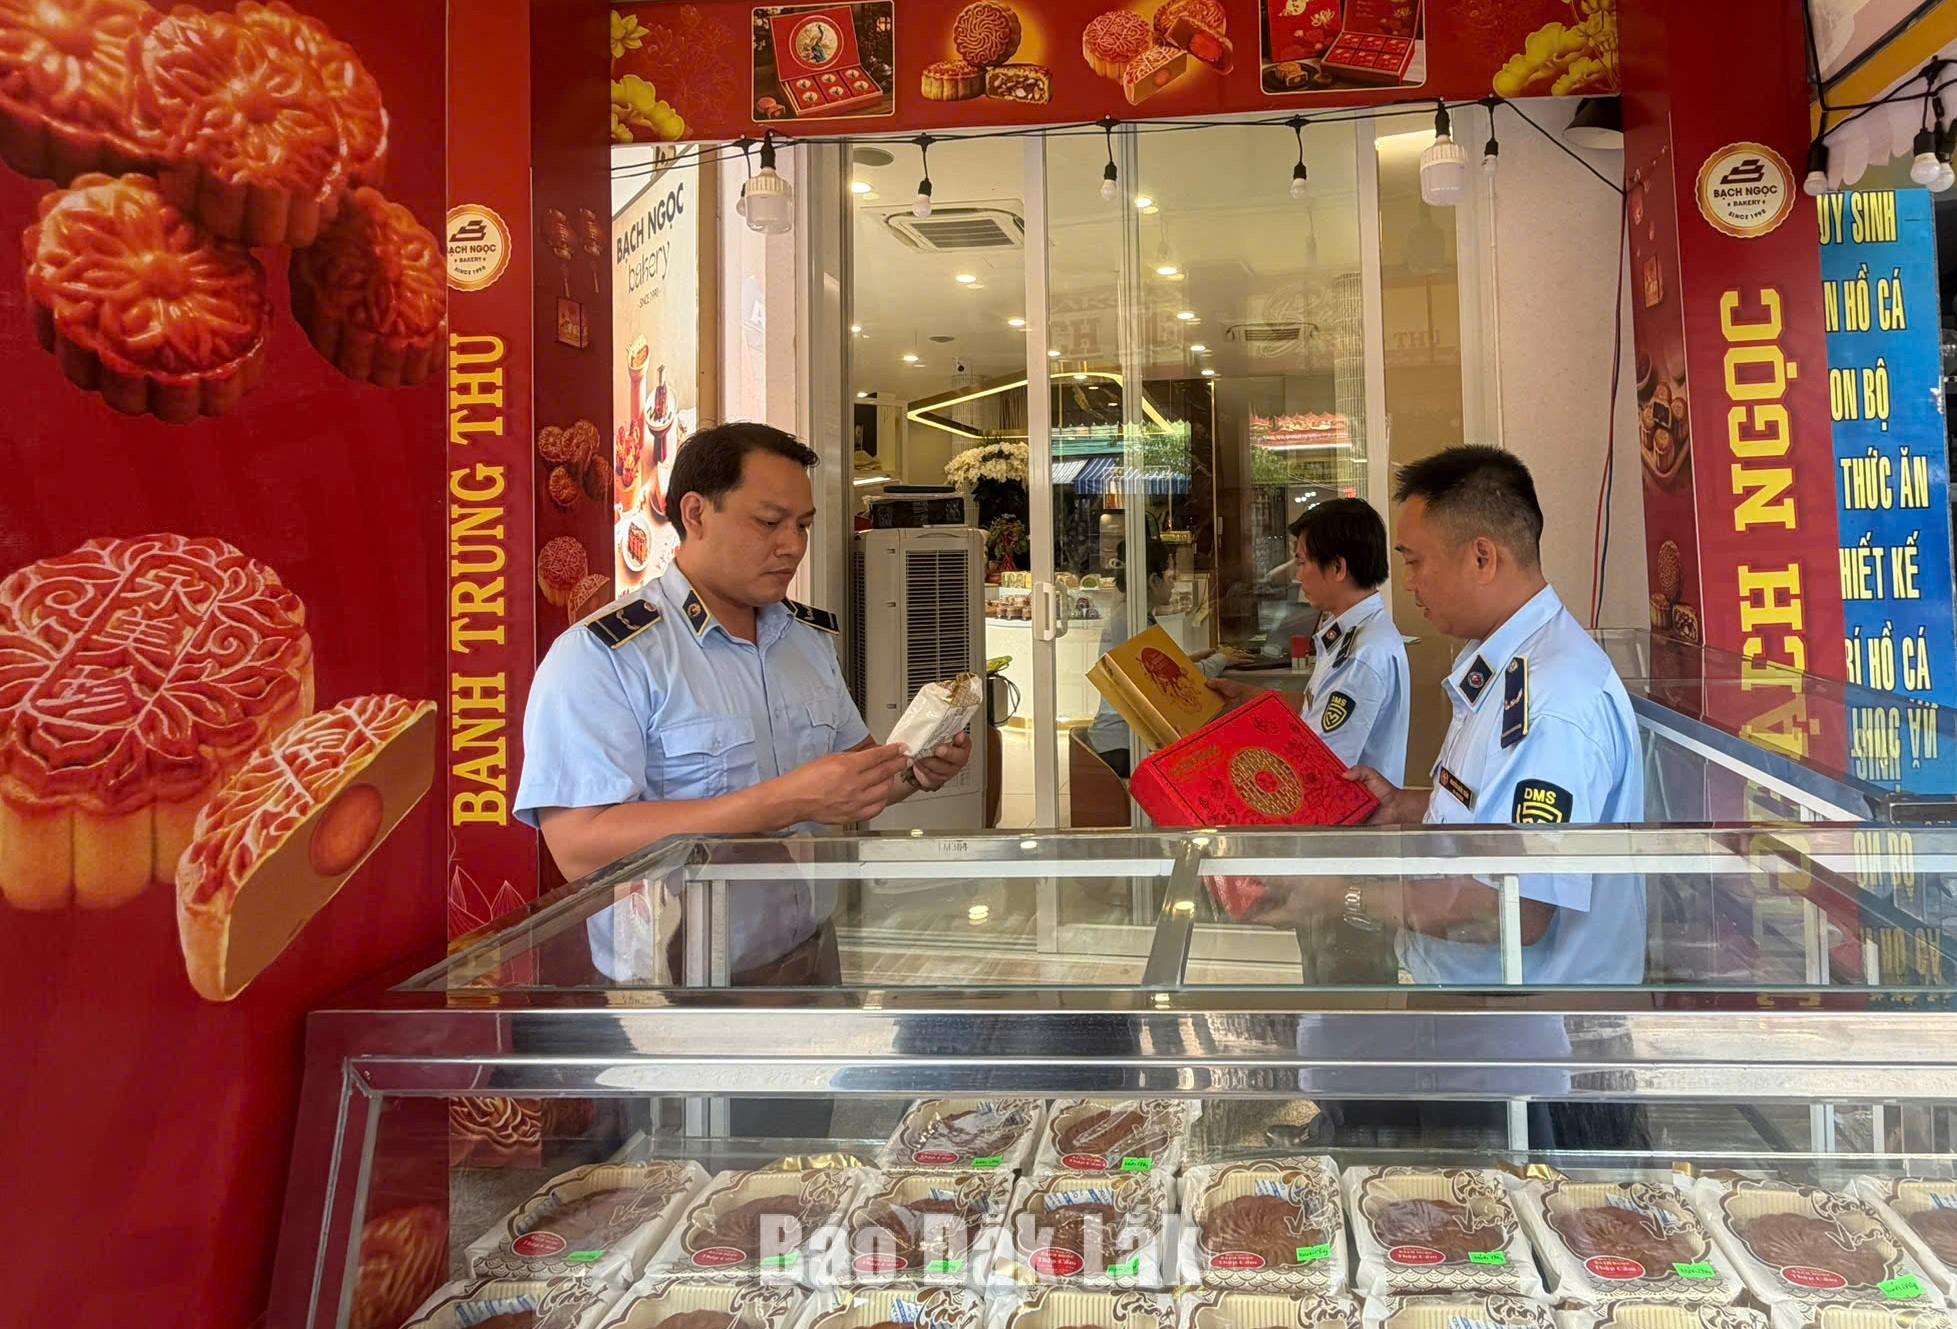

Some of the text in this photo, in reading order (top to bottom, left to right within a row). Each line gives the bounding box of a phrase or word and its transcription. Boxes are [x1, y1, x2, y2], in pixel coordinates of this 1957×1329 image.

[616, 181, 684, 265] BẠCH NGỌC
[1713, 184, 1777, 200] BẠCH NGỌC
[1728, 210, 1749, 219] SINCE
[1850, 191, 1897, 243] SINH
[448, 243, 497, 256] ẠCH NGỌC
[628, 241, 670, 294] bakery
[1823, 263, 1907, 332] N HỒ CÁ
[450, 333, 504, 445] THU
[1719, 288, 1798, 532] NGỌC
[1862, 357, 1890, 431] BỘ
[1840, 446, 1930, 510] THỨC ĂN
[450, 463, 506, 654] TRUNG
[1891, 530, 1920, 599] KẾ
[1867, 620, 1895, 691] HỒ
[1902, 626, 1932, 691] CÁ
[1524, 787, 1557, 805] DMS
